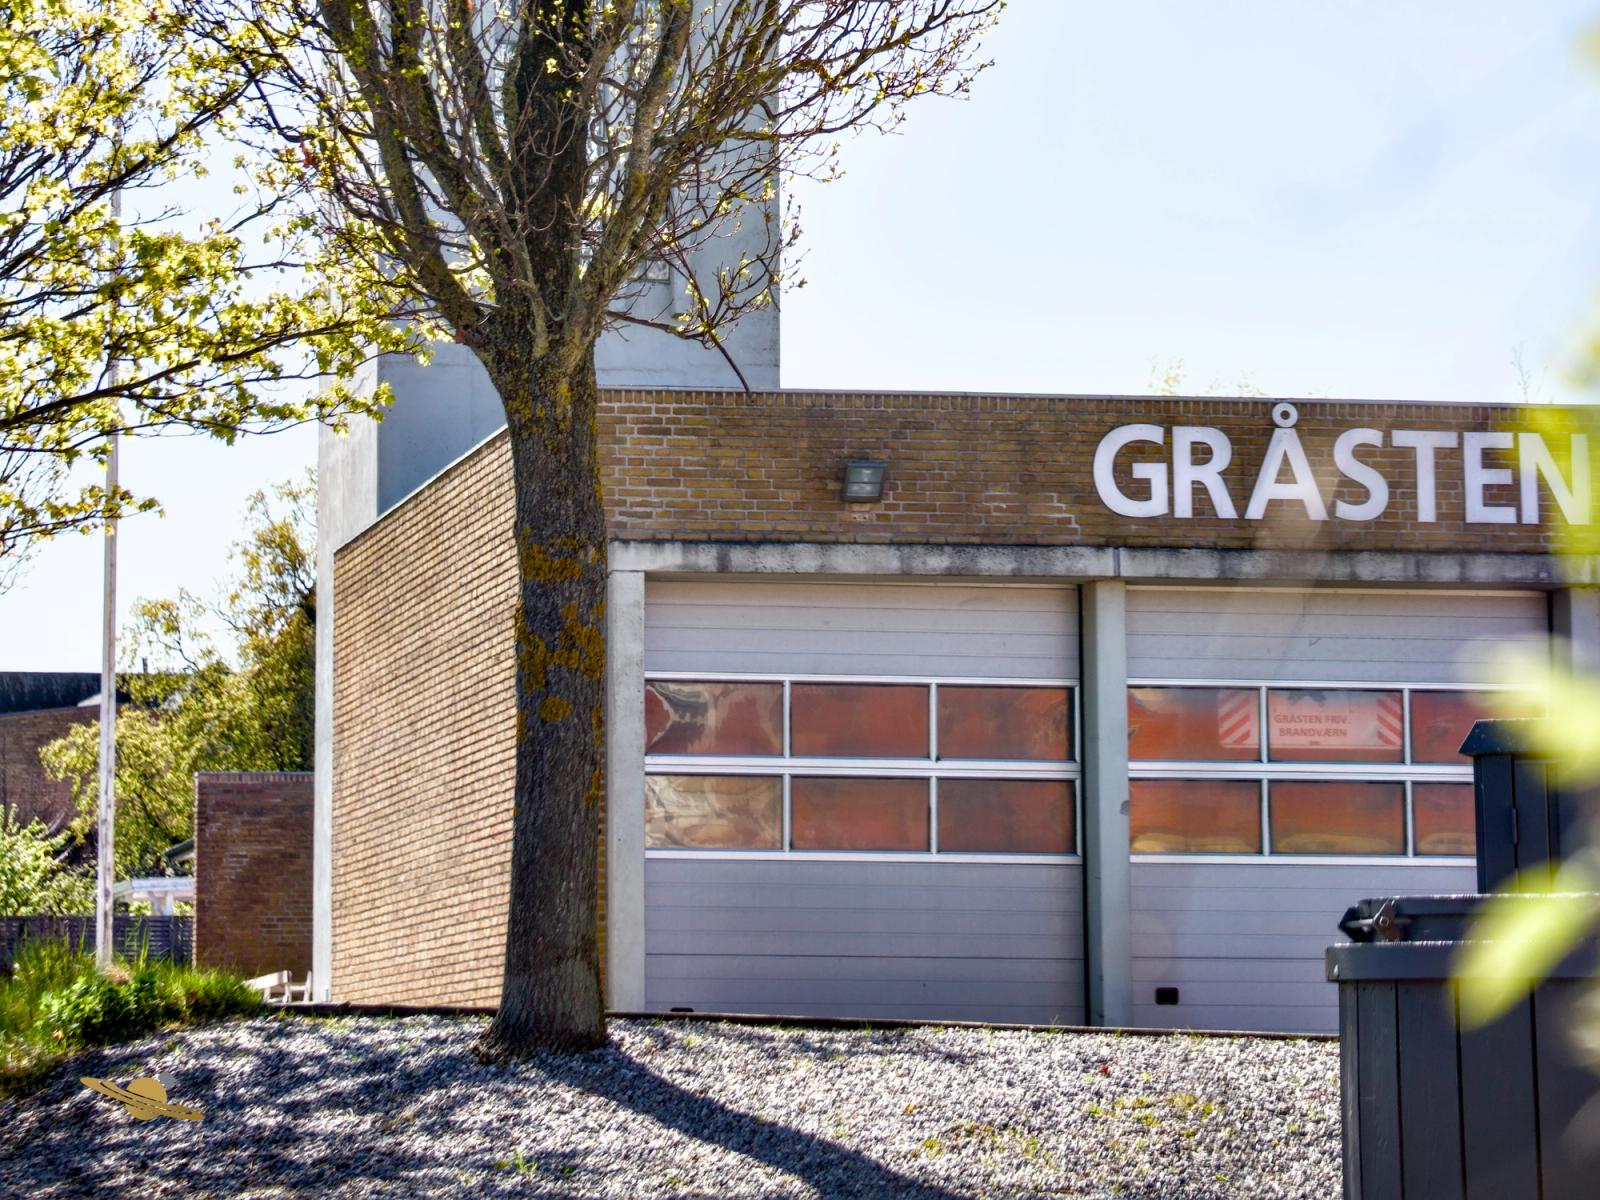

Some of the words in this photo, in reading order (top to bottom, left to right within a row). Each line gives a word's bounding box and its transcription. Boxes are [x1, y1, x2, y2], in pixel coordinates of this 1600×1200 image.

[1093, 402, 1592, 526] GRÅSTEN
[1274, 712, 1322, 724] GRÅSTEN
[1279, 727, 1348, 737] BRANDVÆRN
